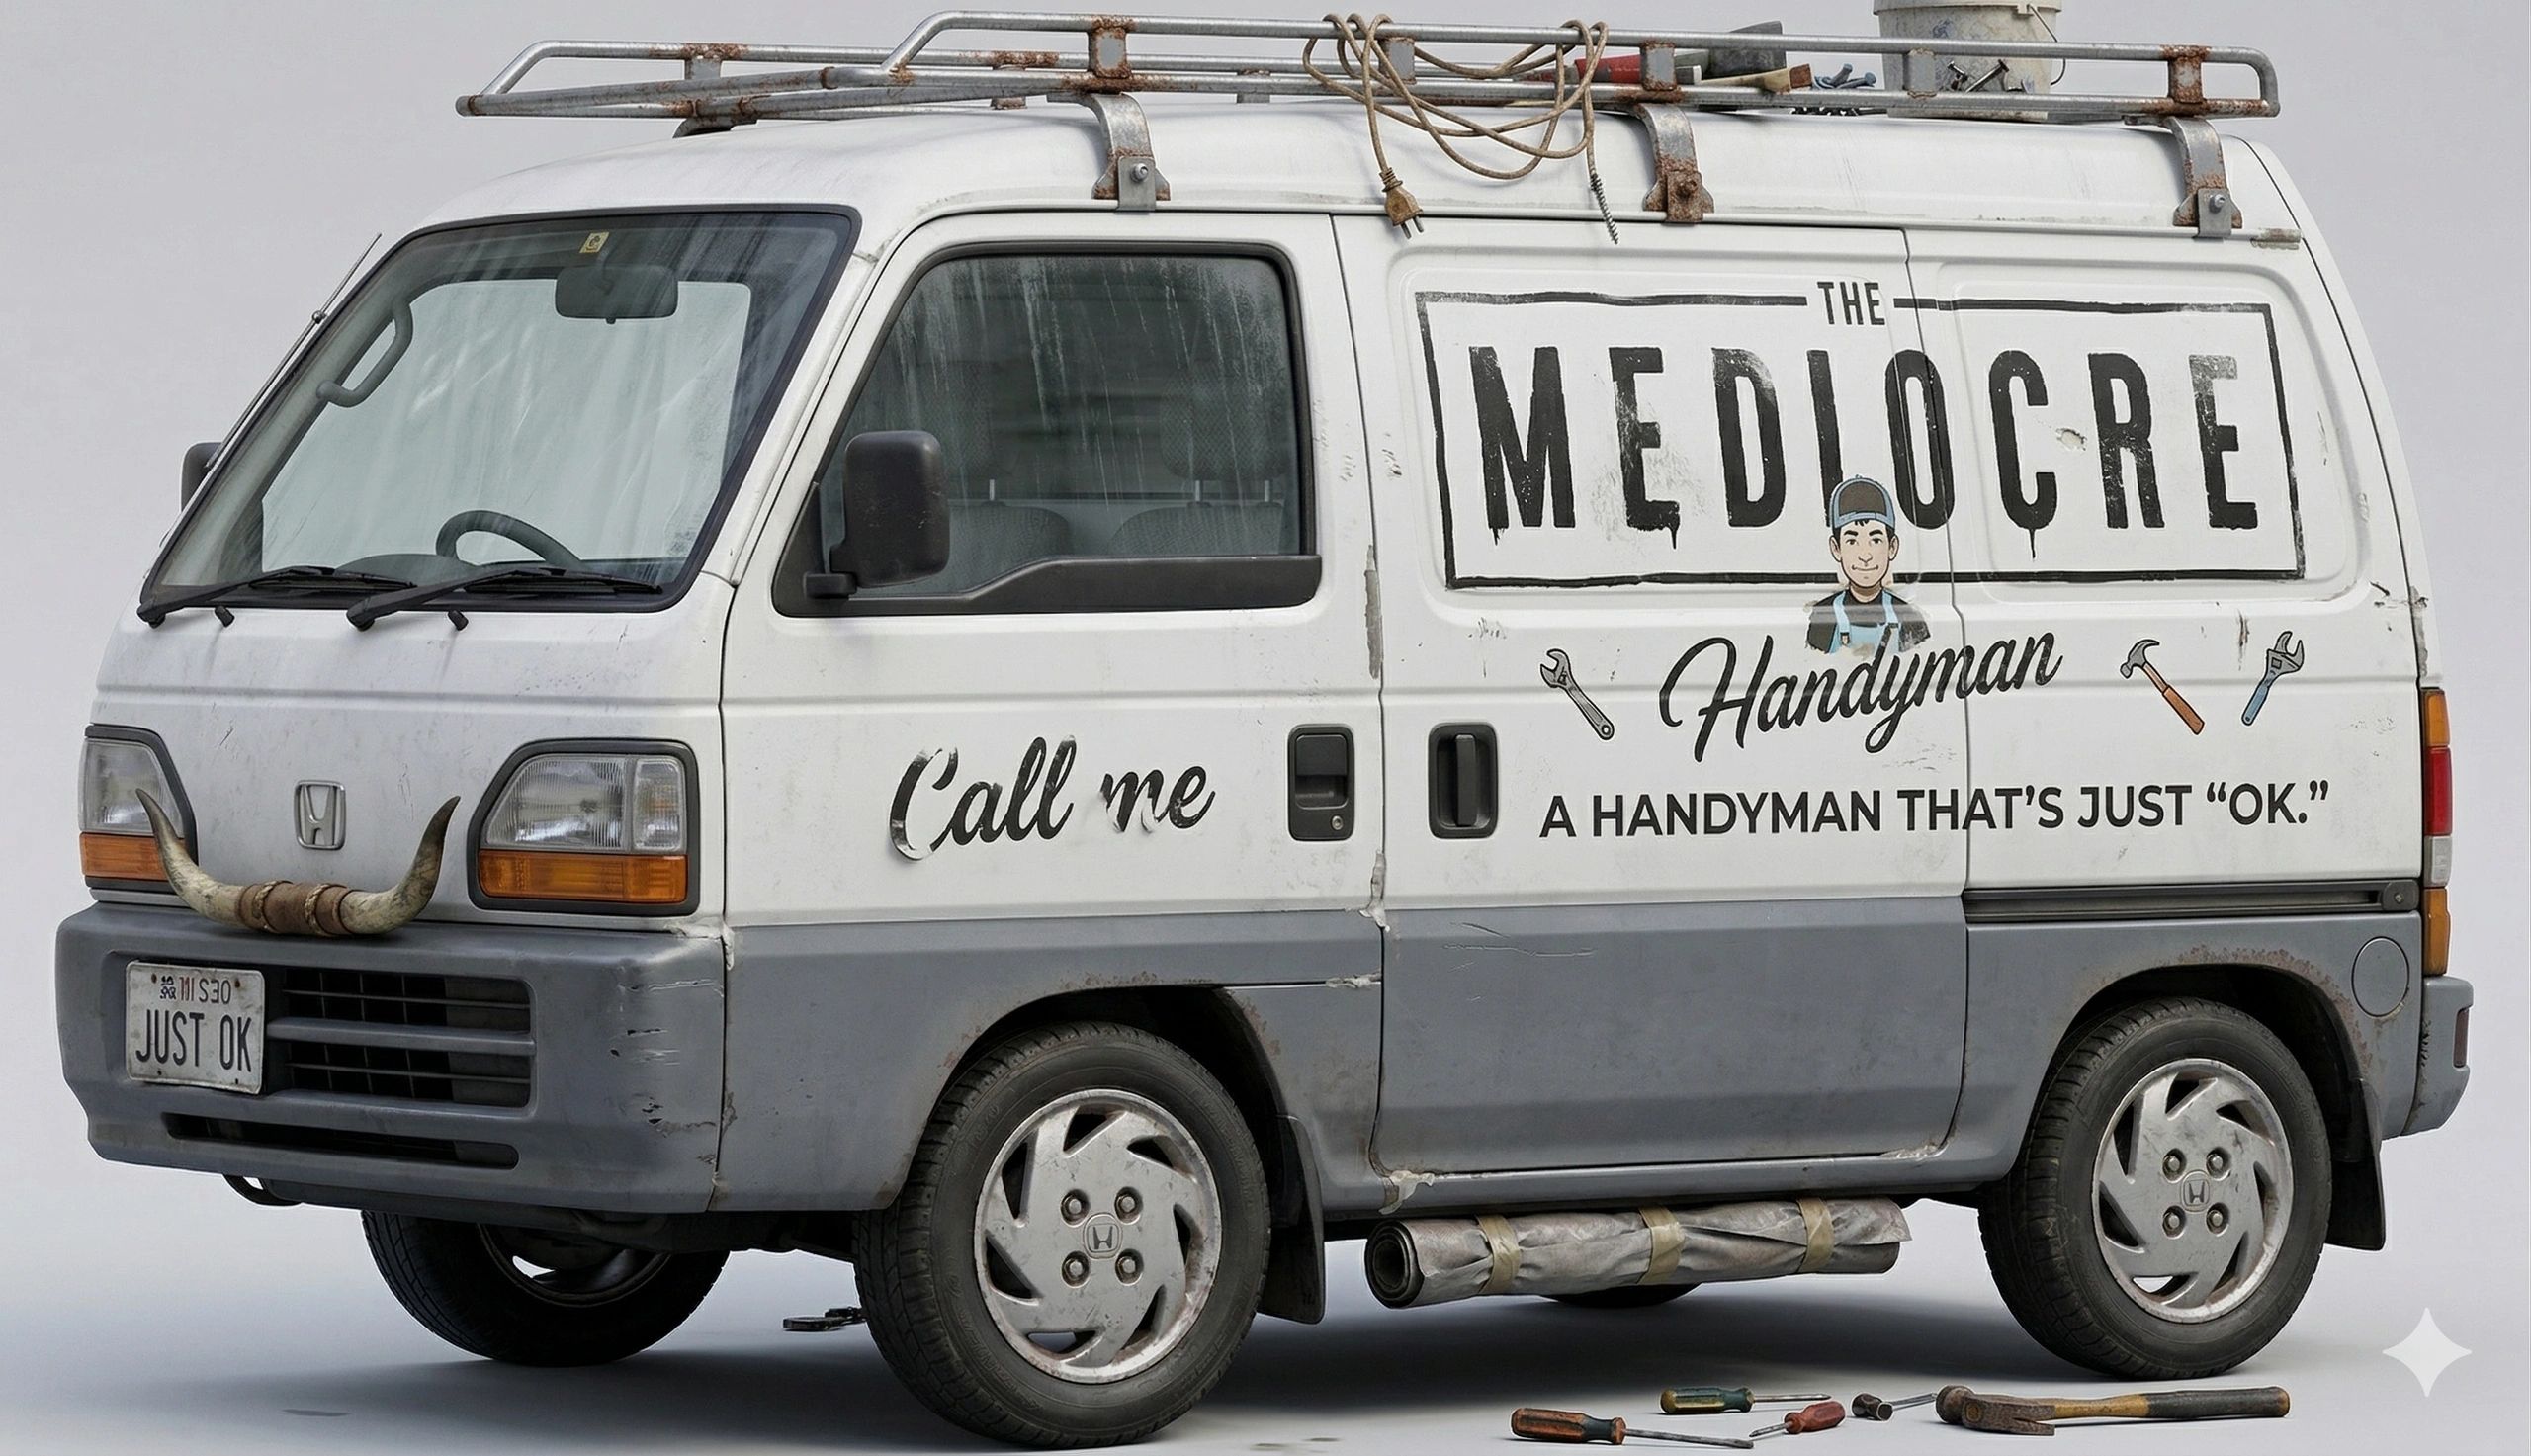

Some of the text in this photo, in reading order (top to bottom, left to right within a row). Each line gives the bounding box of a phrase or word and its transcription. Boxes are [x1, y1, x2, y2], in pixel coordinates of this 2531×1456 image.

[1816, 281, 1885, 326] THE
[1468, 346, 2258, 554] MEDIOCRE
[1659, 624, 2064, 763] Handyman
[889, 734, 1217, 862] Call me
[1538, 779, 2329, 838] A HANDYMAN THAT’S JUST “OK.”
[135, 1008, 252, 1073] JUST OK
